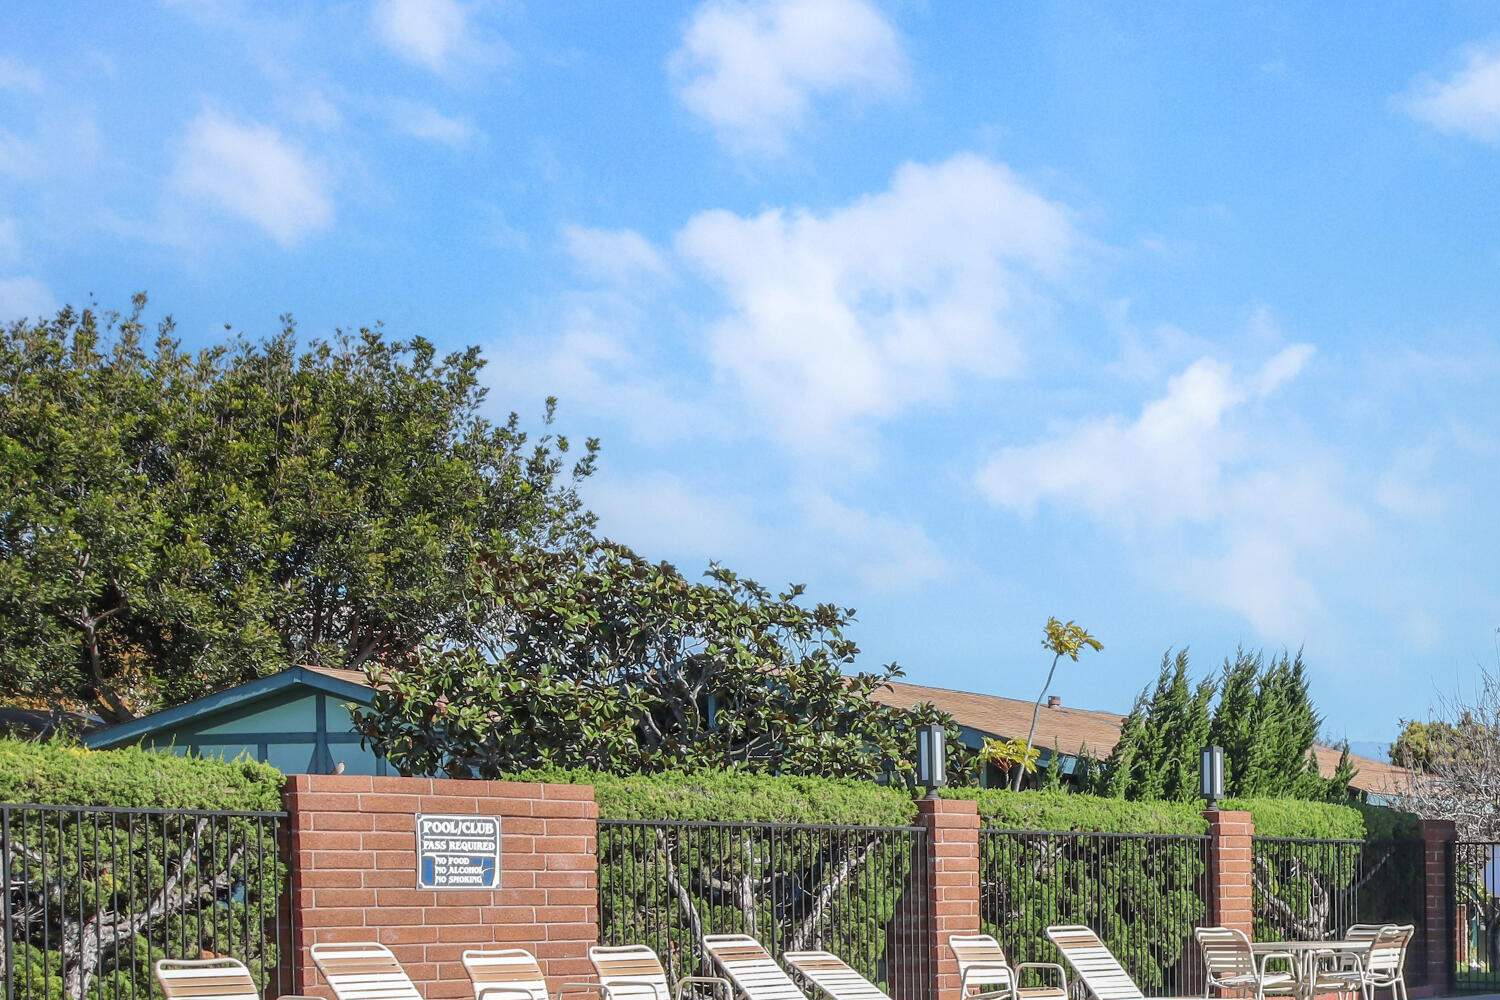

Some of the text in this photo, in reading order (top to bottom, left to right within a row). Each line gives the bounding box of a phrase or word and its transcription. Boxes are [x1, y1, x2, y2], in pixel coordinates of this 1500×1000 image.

[423, 821, 494, 835] POOL/CLUB
[423, 841, 496, 851] PASS REQUIRED
[435, 857, 470, 865] NO FOOD
[435, 866, 483, 874] NO ALCOHOL
